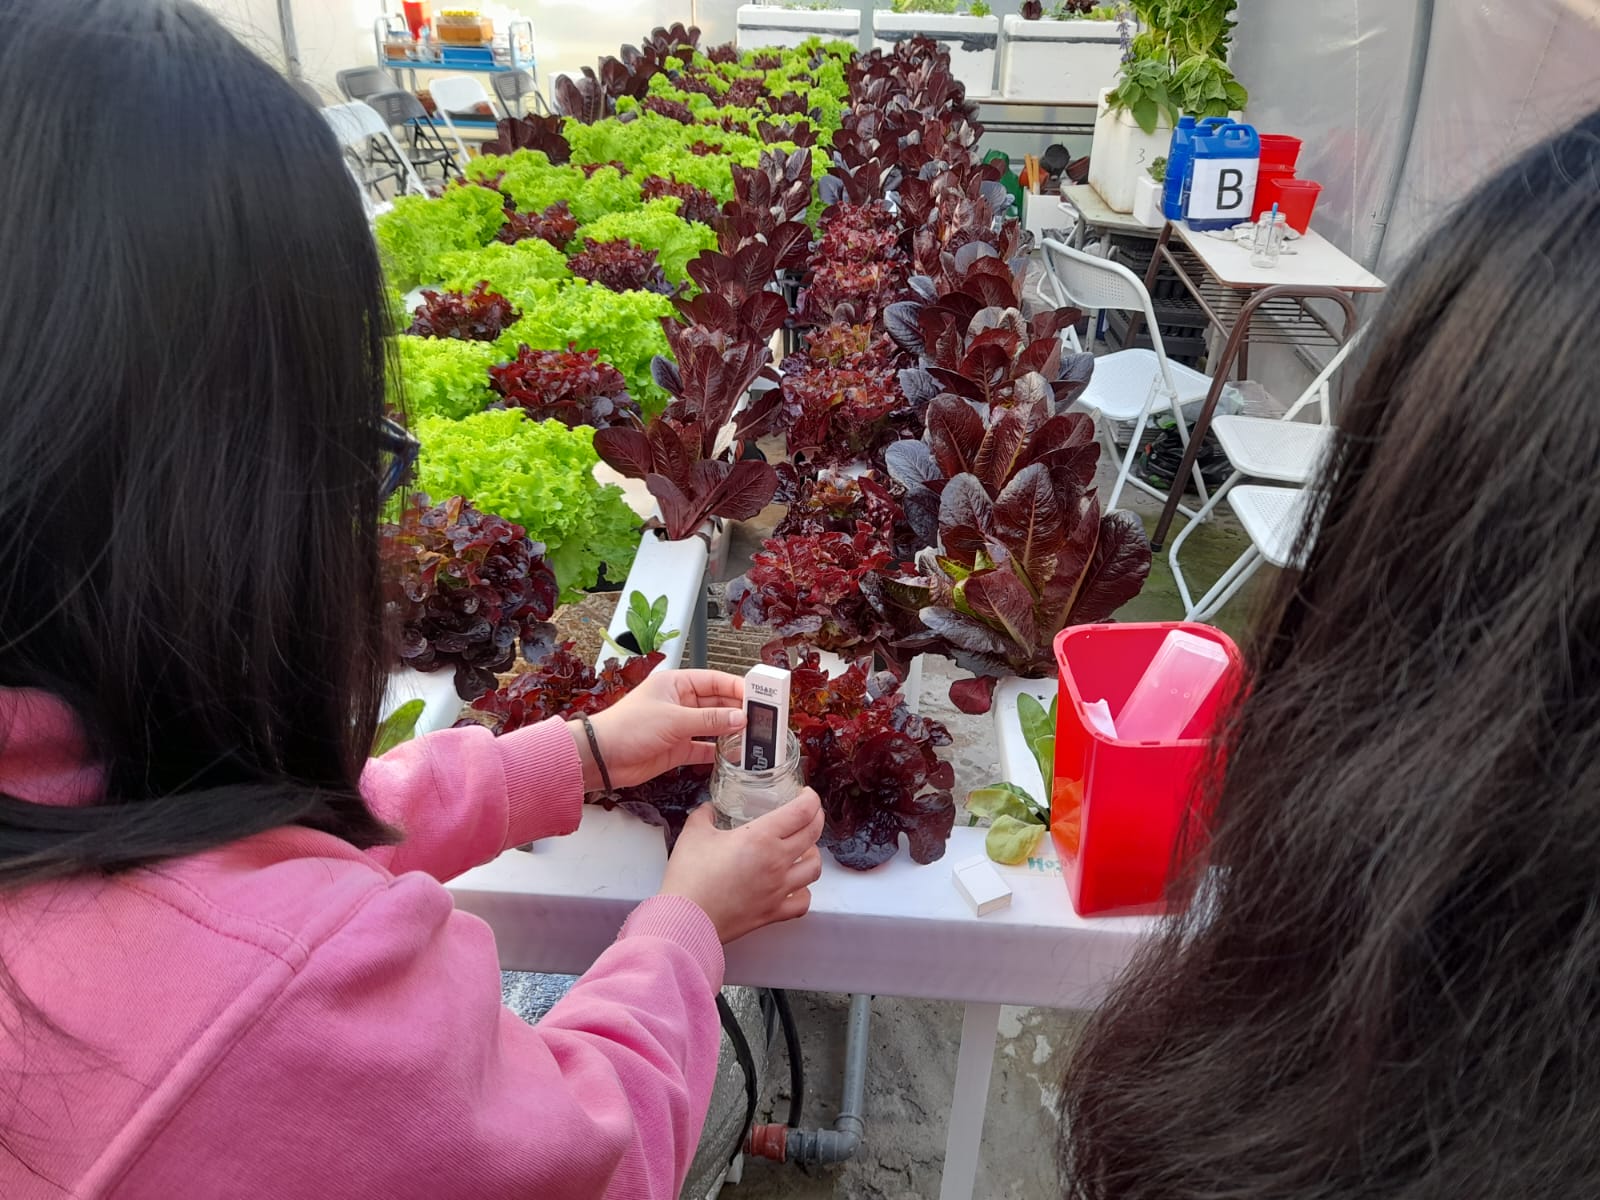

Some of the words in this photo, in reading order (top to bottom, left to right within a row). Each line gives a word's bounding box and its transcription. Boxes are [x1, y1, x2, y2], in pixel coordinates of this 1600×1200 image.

[1135, 147, 1145, 164] 3
[1216, 168, 1244, 211] B
[751, 683, 778, 695] TDS&EC
